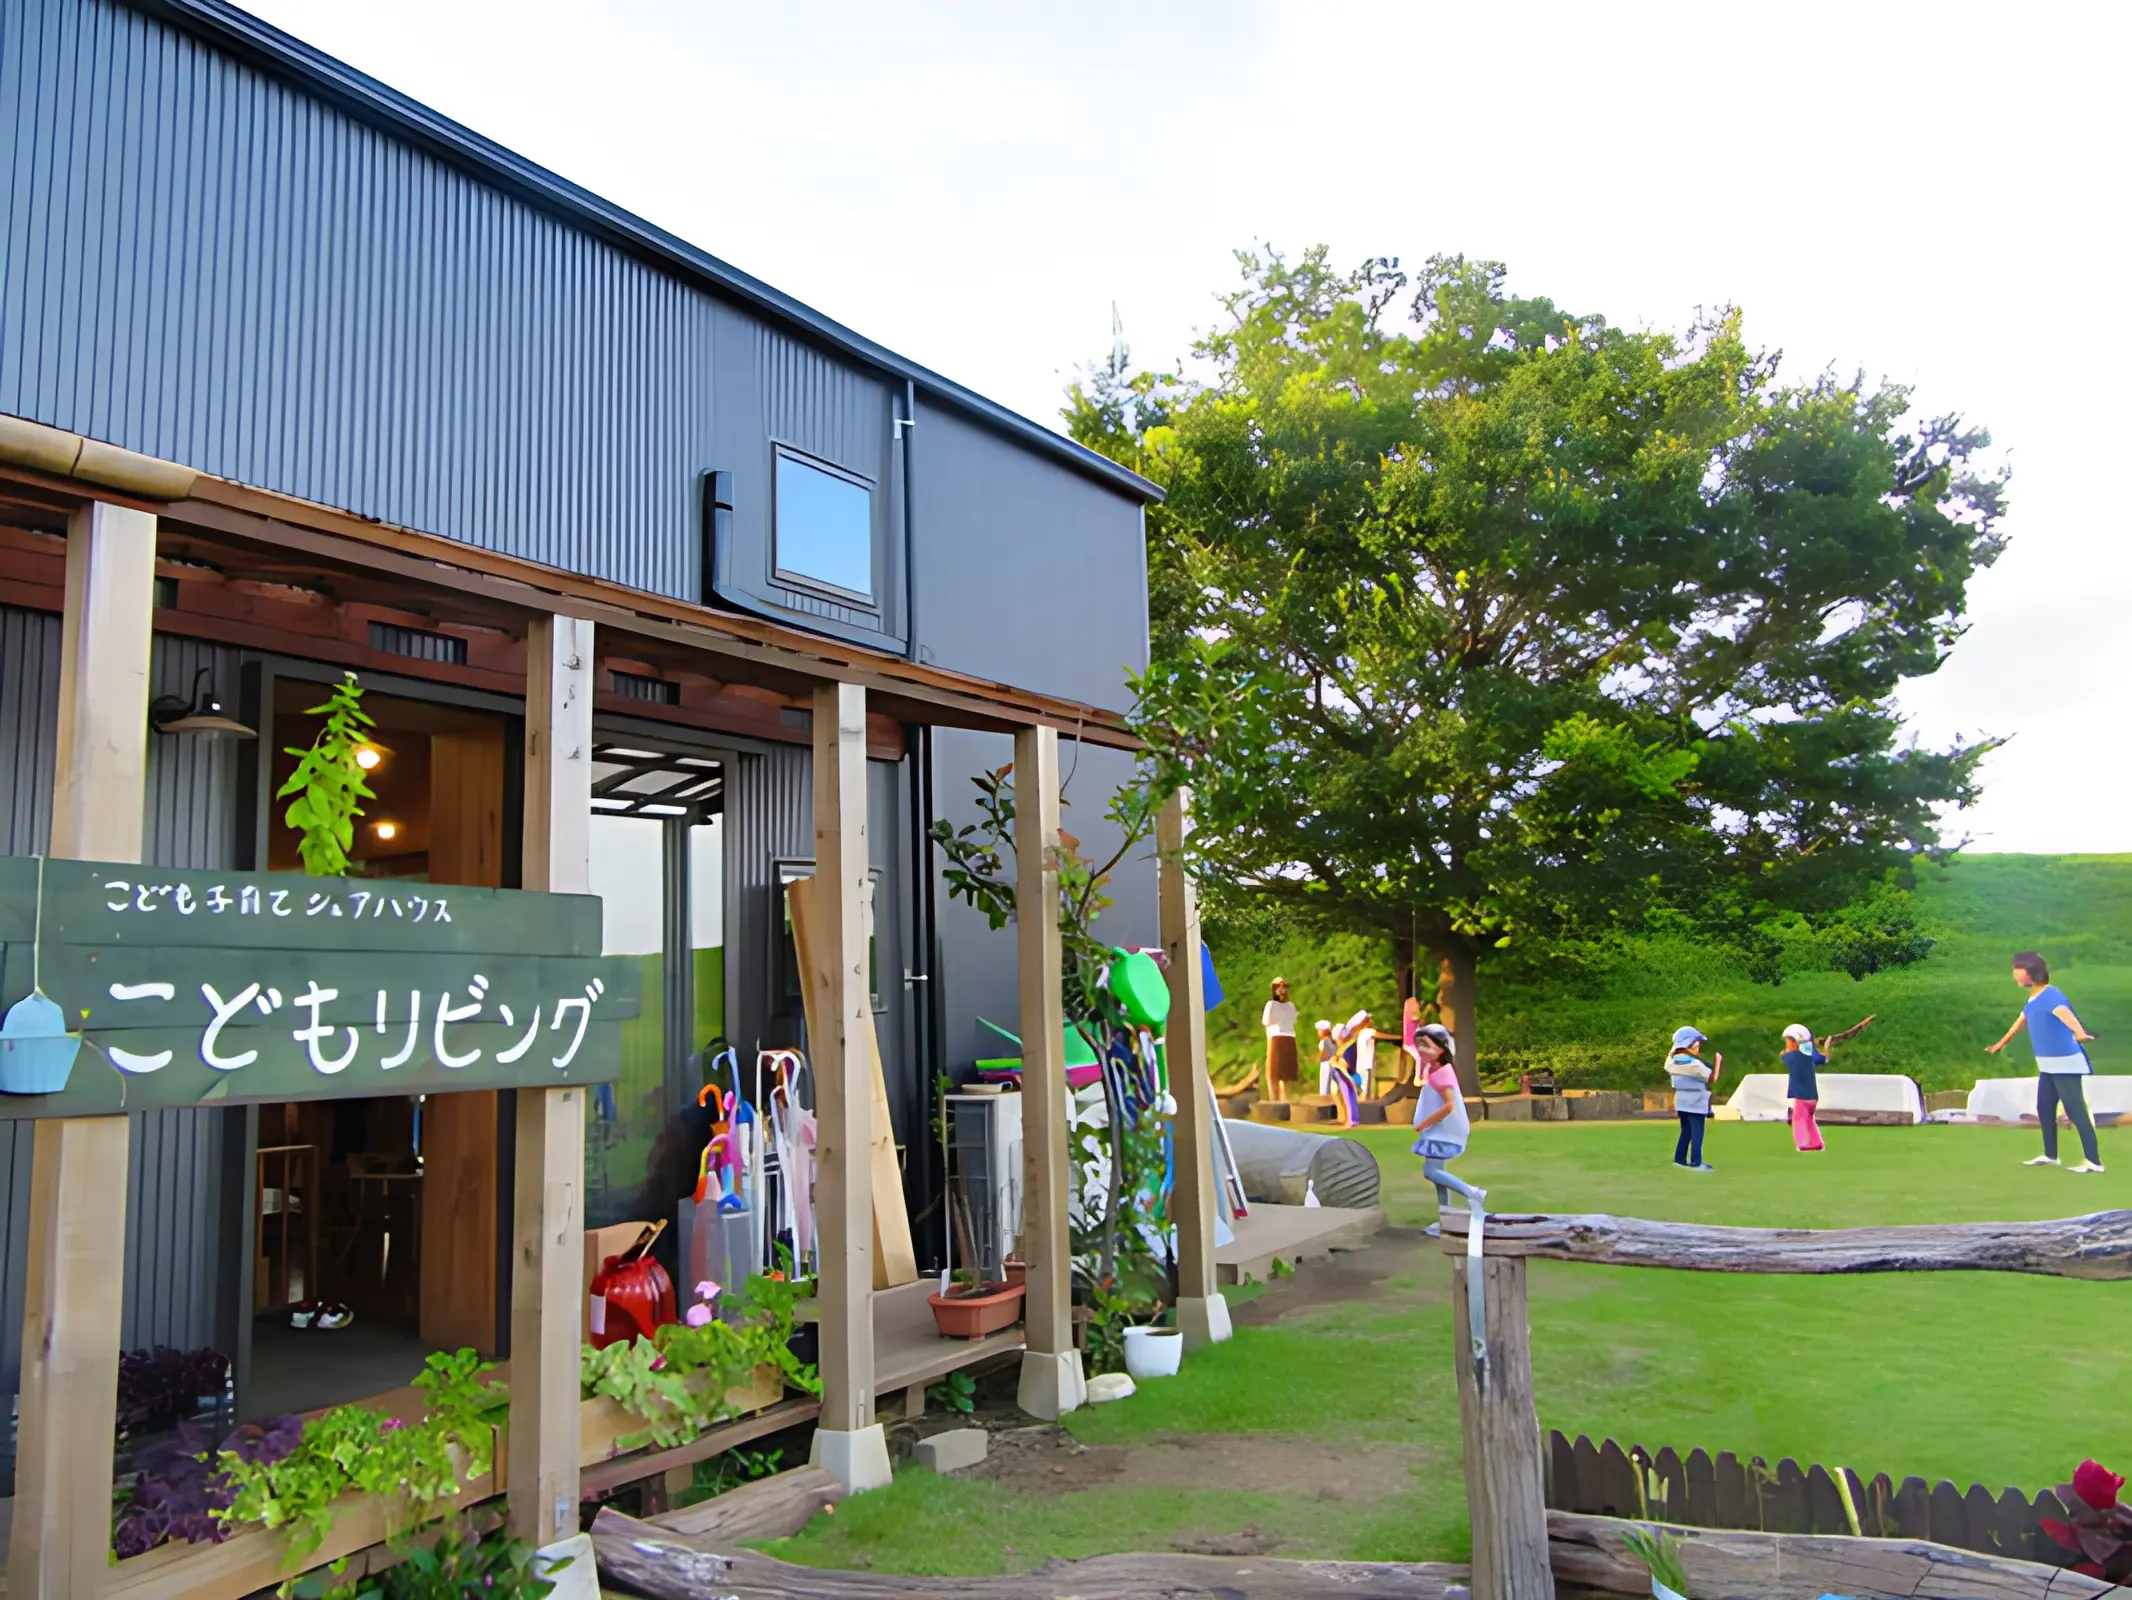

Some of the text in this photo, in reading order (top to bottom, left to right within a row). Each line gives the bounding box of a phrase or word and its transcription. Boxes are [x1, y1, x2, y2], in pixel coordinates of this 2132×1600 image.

[109, 974, 604, 1075] こどもリビング
